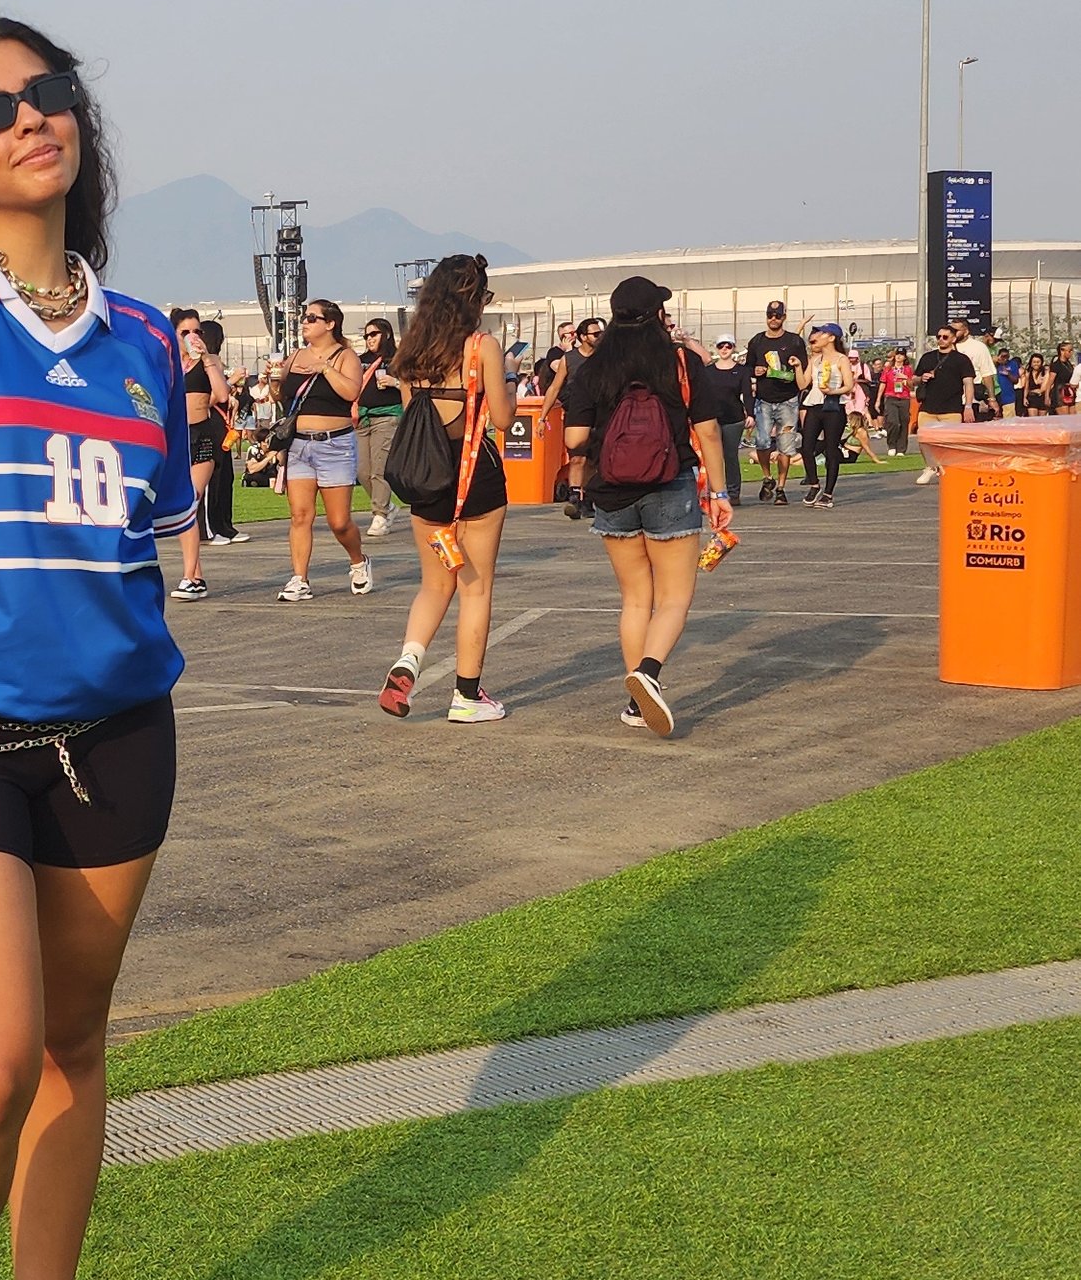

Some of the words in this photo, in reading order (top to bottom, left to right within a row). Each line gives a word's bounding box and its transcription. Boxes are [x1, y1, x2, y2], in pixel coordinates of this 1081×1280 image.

[45, 375, 88, 387] adidas
[45, 433, 128, 527] 10
[968, 489, 978, 503] é
[983, 490, 1024, 507] aqui.
[969, 510, 1022, 519] #riomaislimpo
[990, 524, 1026, 542] Rio
[969, 556, 1021, 567] COMLURB
